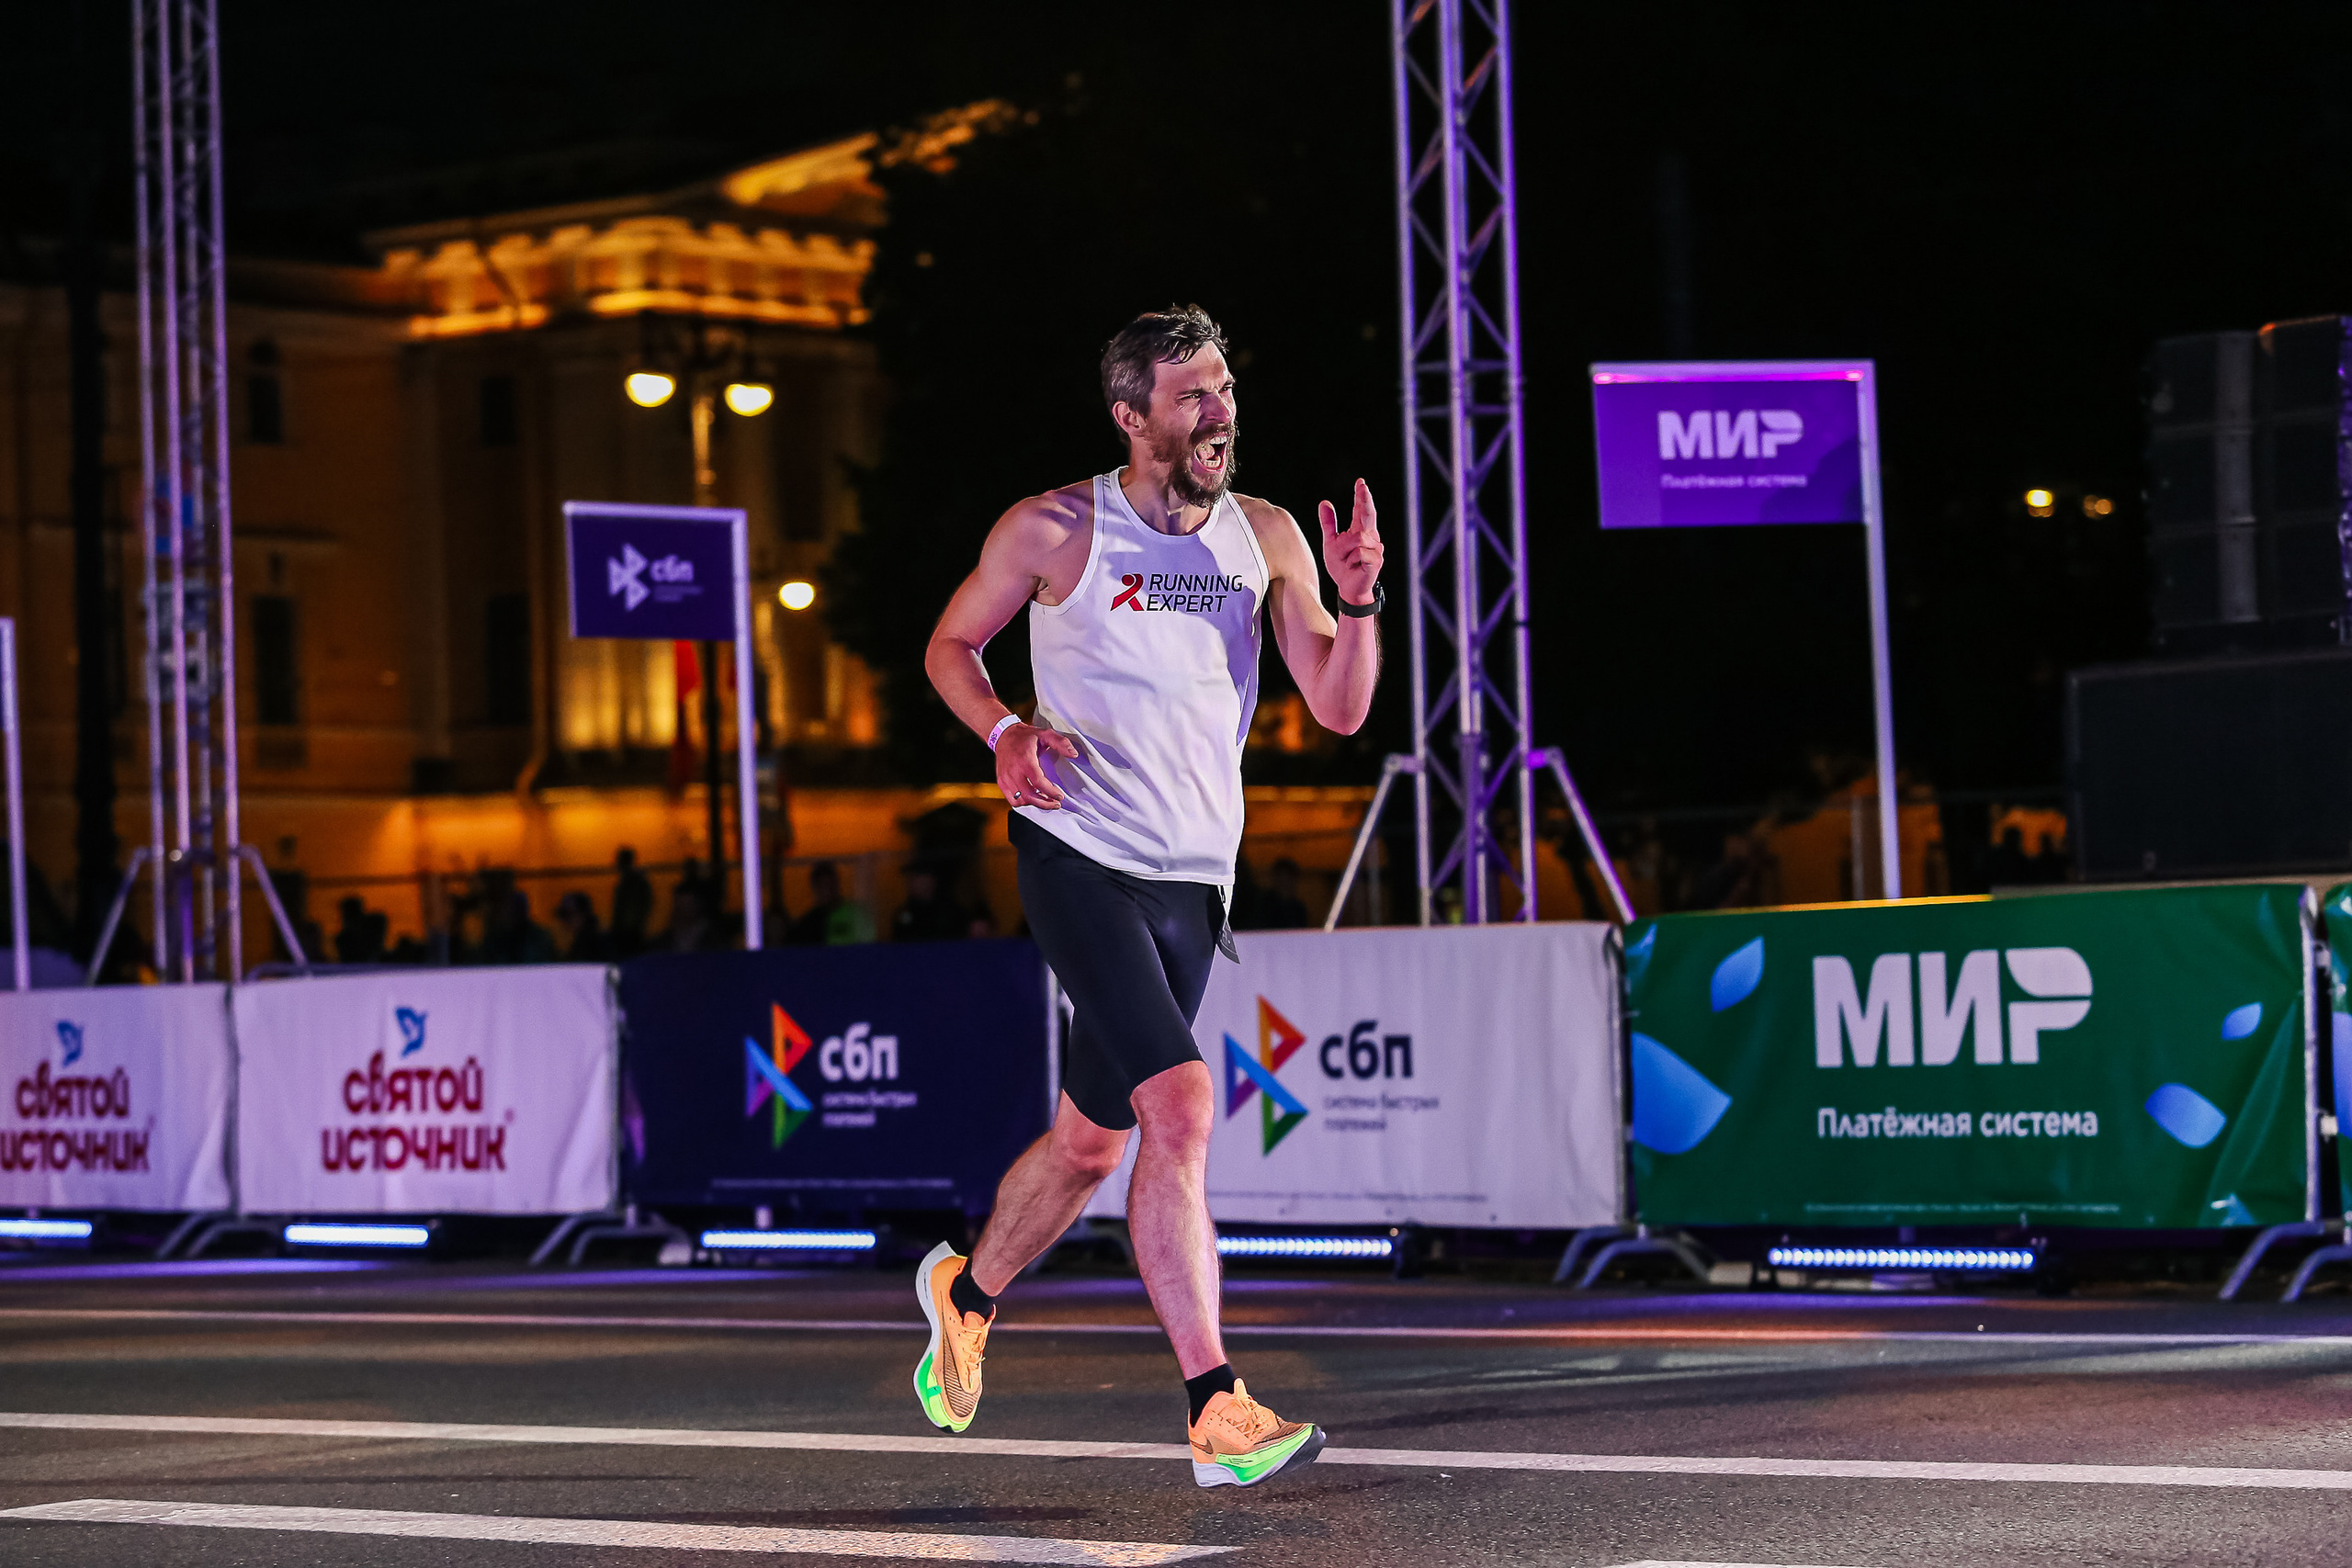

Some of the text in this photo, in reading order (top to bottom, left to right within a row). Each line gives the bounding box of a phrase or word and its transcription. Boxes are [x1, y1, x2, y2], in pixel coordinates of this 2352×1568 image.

[1657, 409, 1804, 459] МИР
[1146, 593, 1227, 613] EXPERT
[1148, 573, 1243, 592] RUNNING
[1813, 946, 2093, 1068] МИР
[819, 1021, 899, 1082] сбп
[1319, 1019, 1414, 1080] сбп
[1818, 1107, 2098, 1138] Платёжная система
